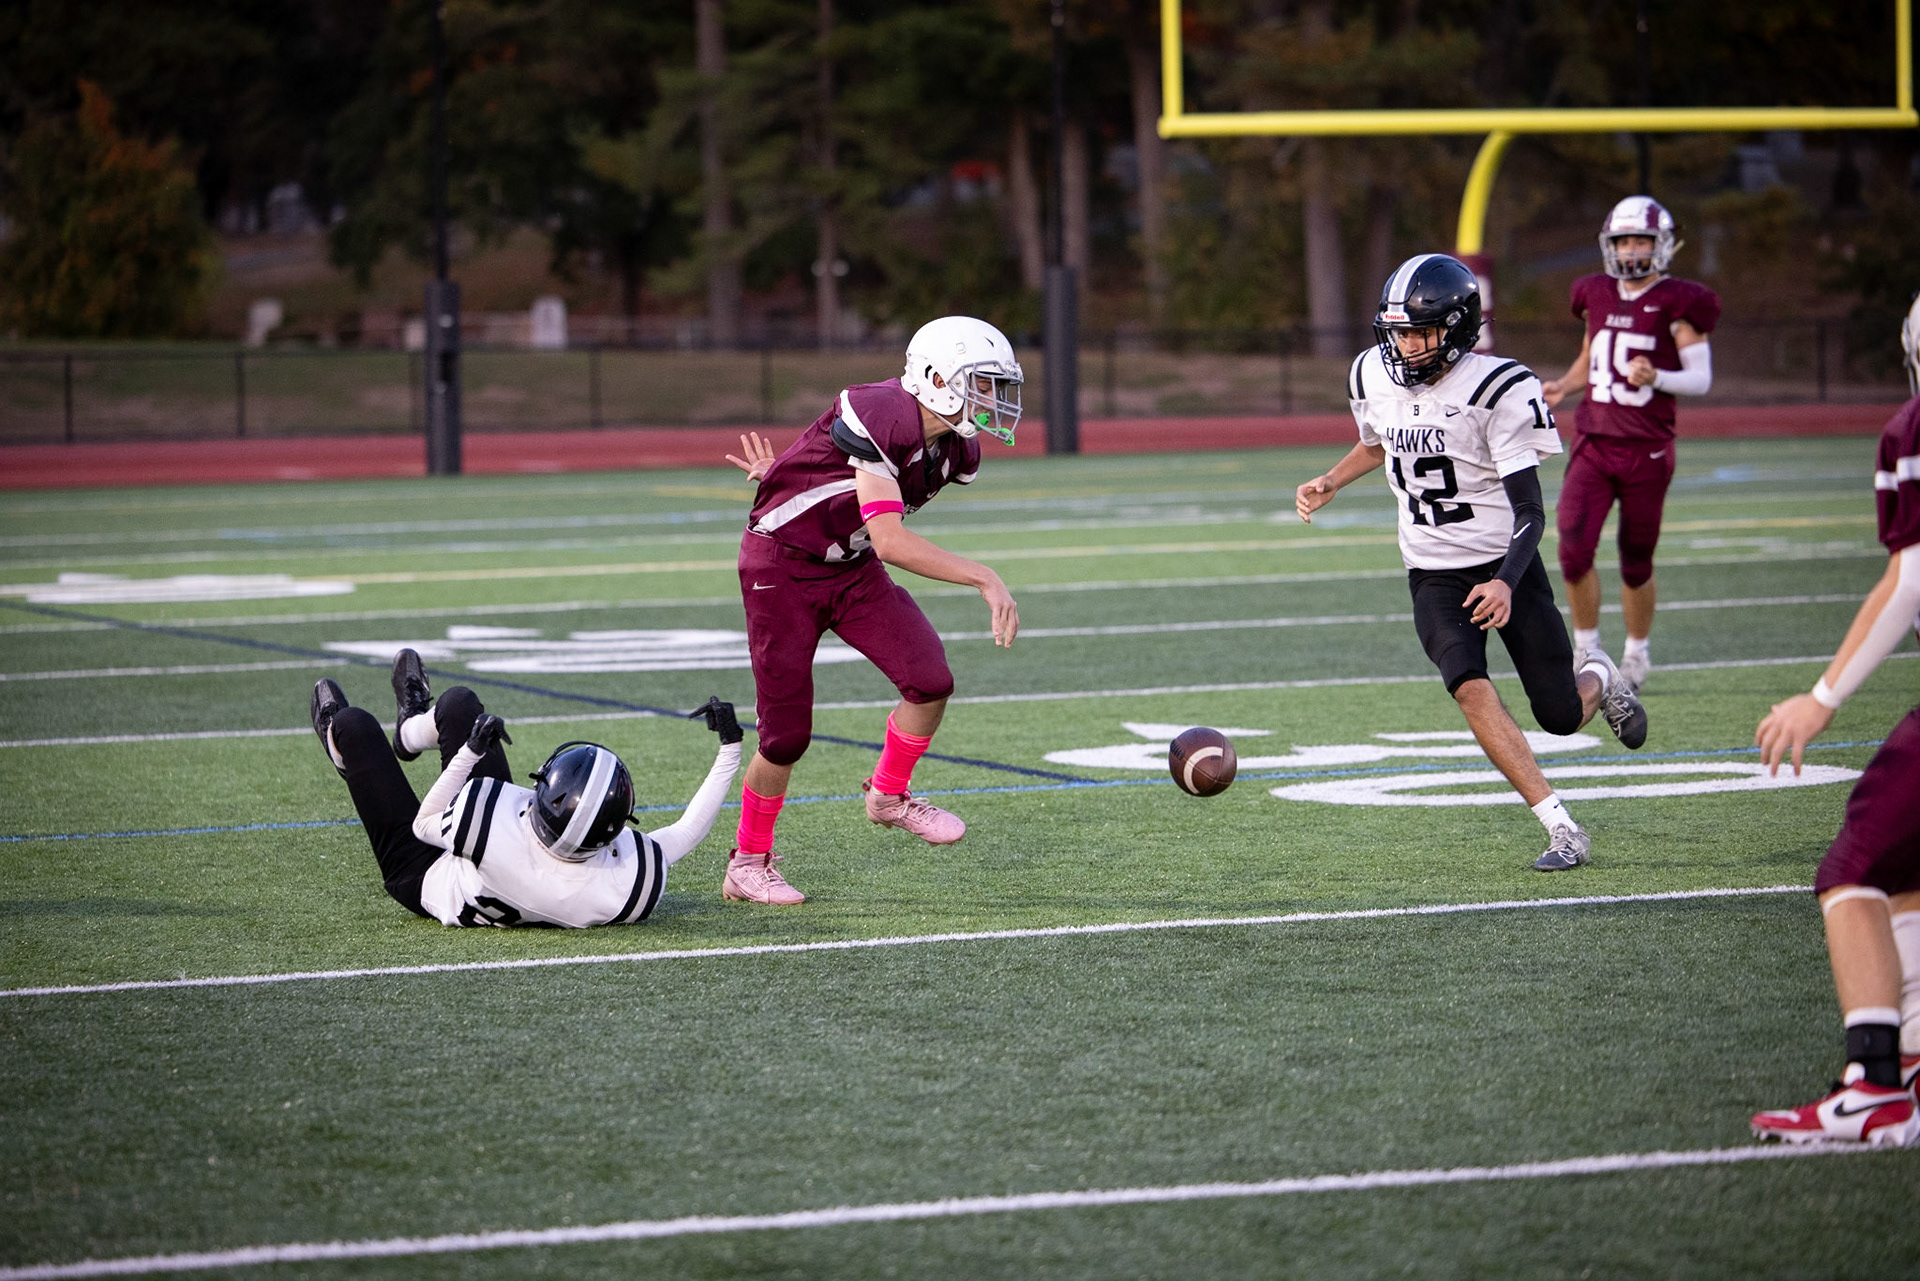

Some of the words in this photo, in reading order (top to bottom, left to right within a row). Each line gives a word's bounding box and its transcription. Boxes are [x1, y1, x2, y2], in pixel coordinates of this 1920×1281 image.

[1589, 329, 1657, 407] 45
[1413, 405, 1419, 416] B
[1386, 427, 1445, 453] HAWKS
[1391, 455, 1475, 527] 12
